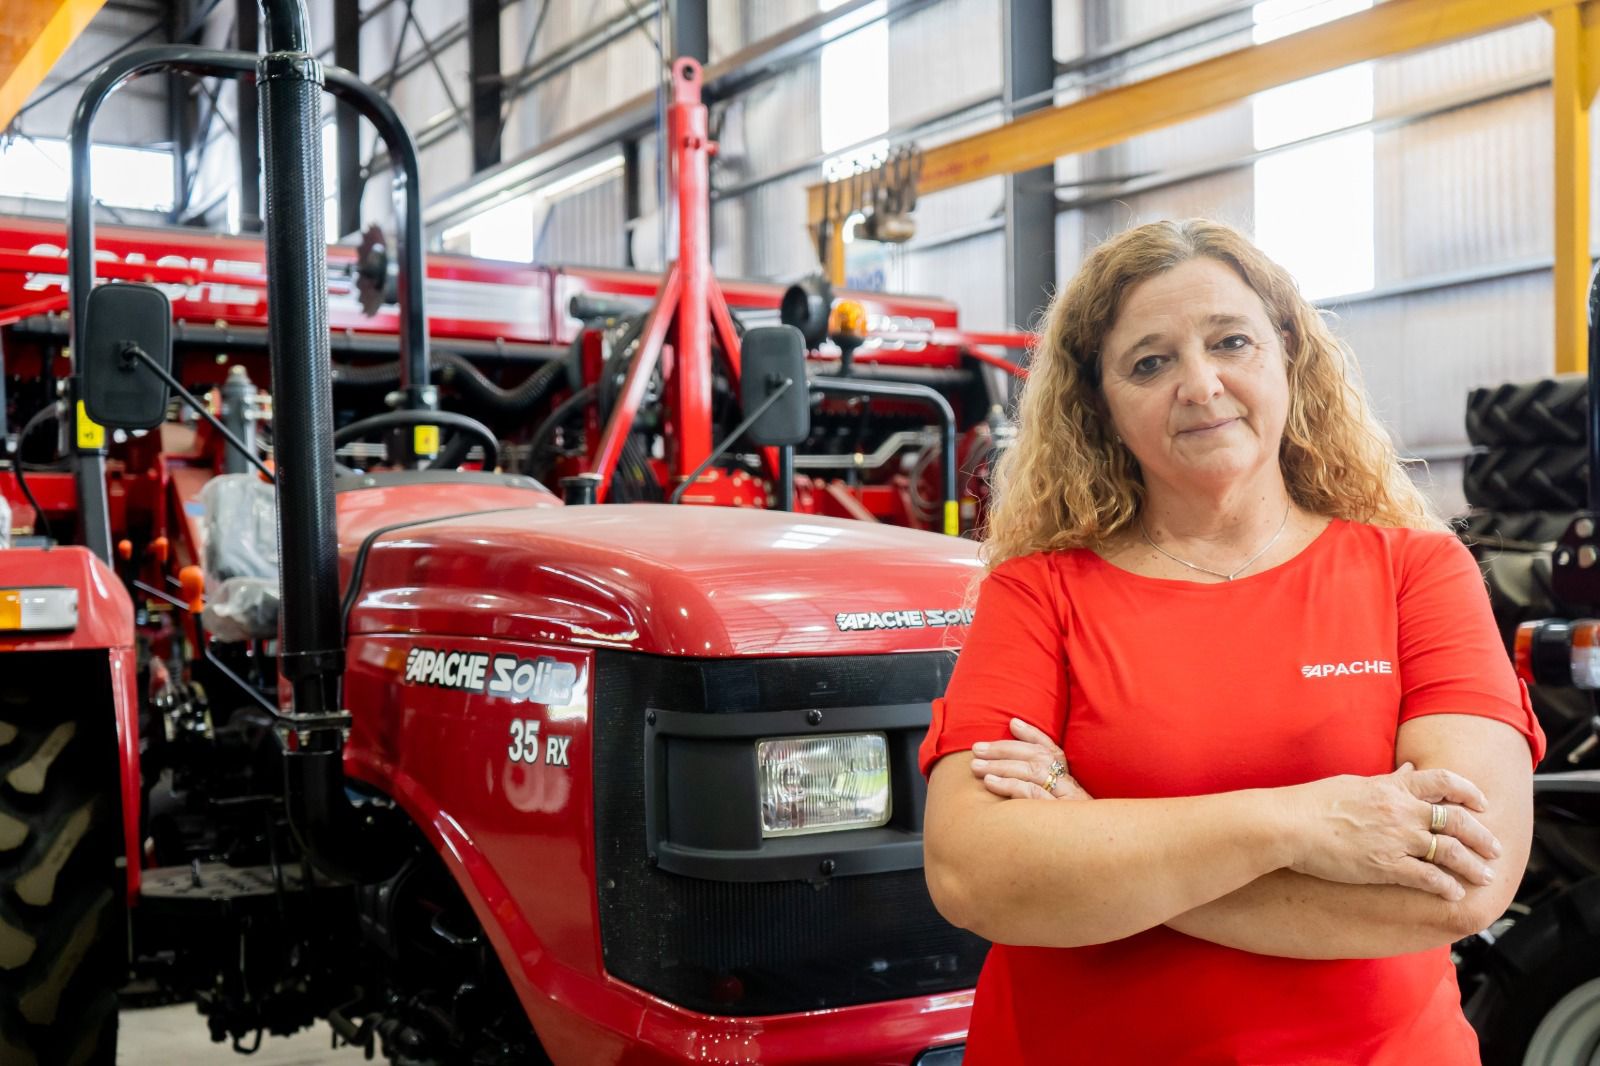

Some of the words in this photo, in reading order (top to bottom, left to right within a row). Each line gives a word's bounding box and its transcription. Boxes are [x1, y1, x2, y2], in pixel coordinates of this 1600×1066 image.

[835, 611, 923, 630] APACHE
[405, 648, 489, 690] APACHE
[1301, 660, 1393, 678] APACHE
[508, 718, 540, 764] 35
[545, 736, 571, 766] RX
